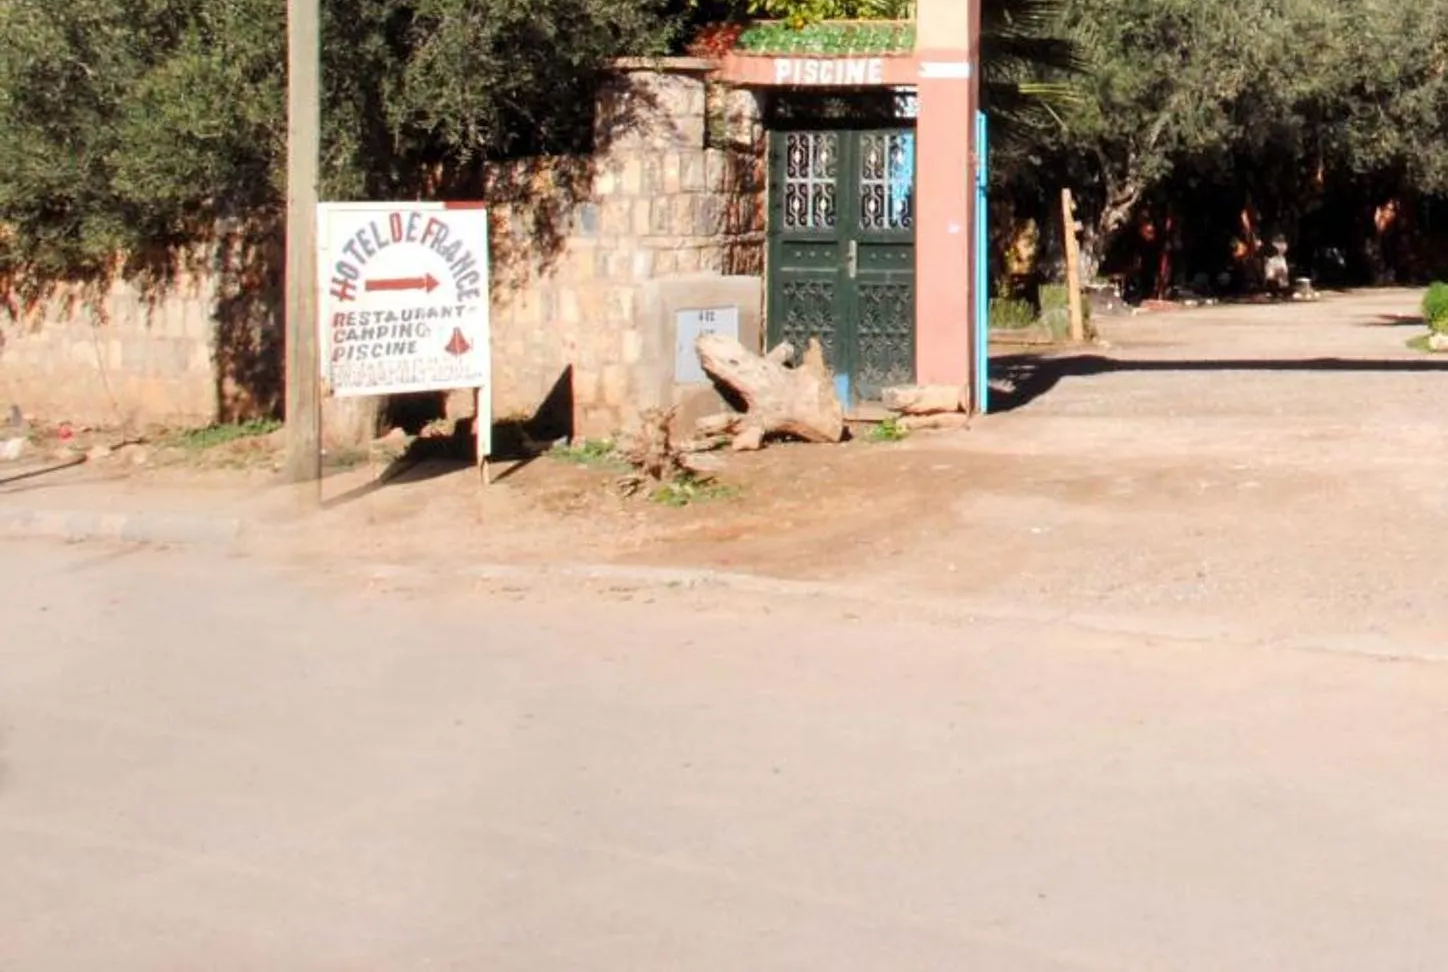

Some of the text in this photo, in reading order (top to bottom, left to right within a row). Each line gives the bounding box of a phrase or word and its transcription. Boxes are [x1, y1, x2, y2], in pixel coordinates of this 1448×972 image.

[775, 58, 882, 85] PISCINE
[330, 211, 479, 302] HOTEL DE FRANCE
[334, 323, 431, 343] CAMPING
[332, 341, 417, 362] PISCINE
